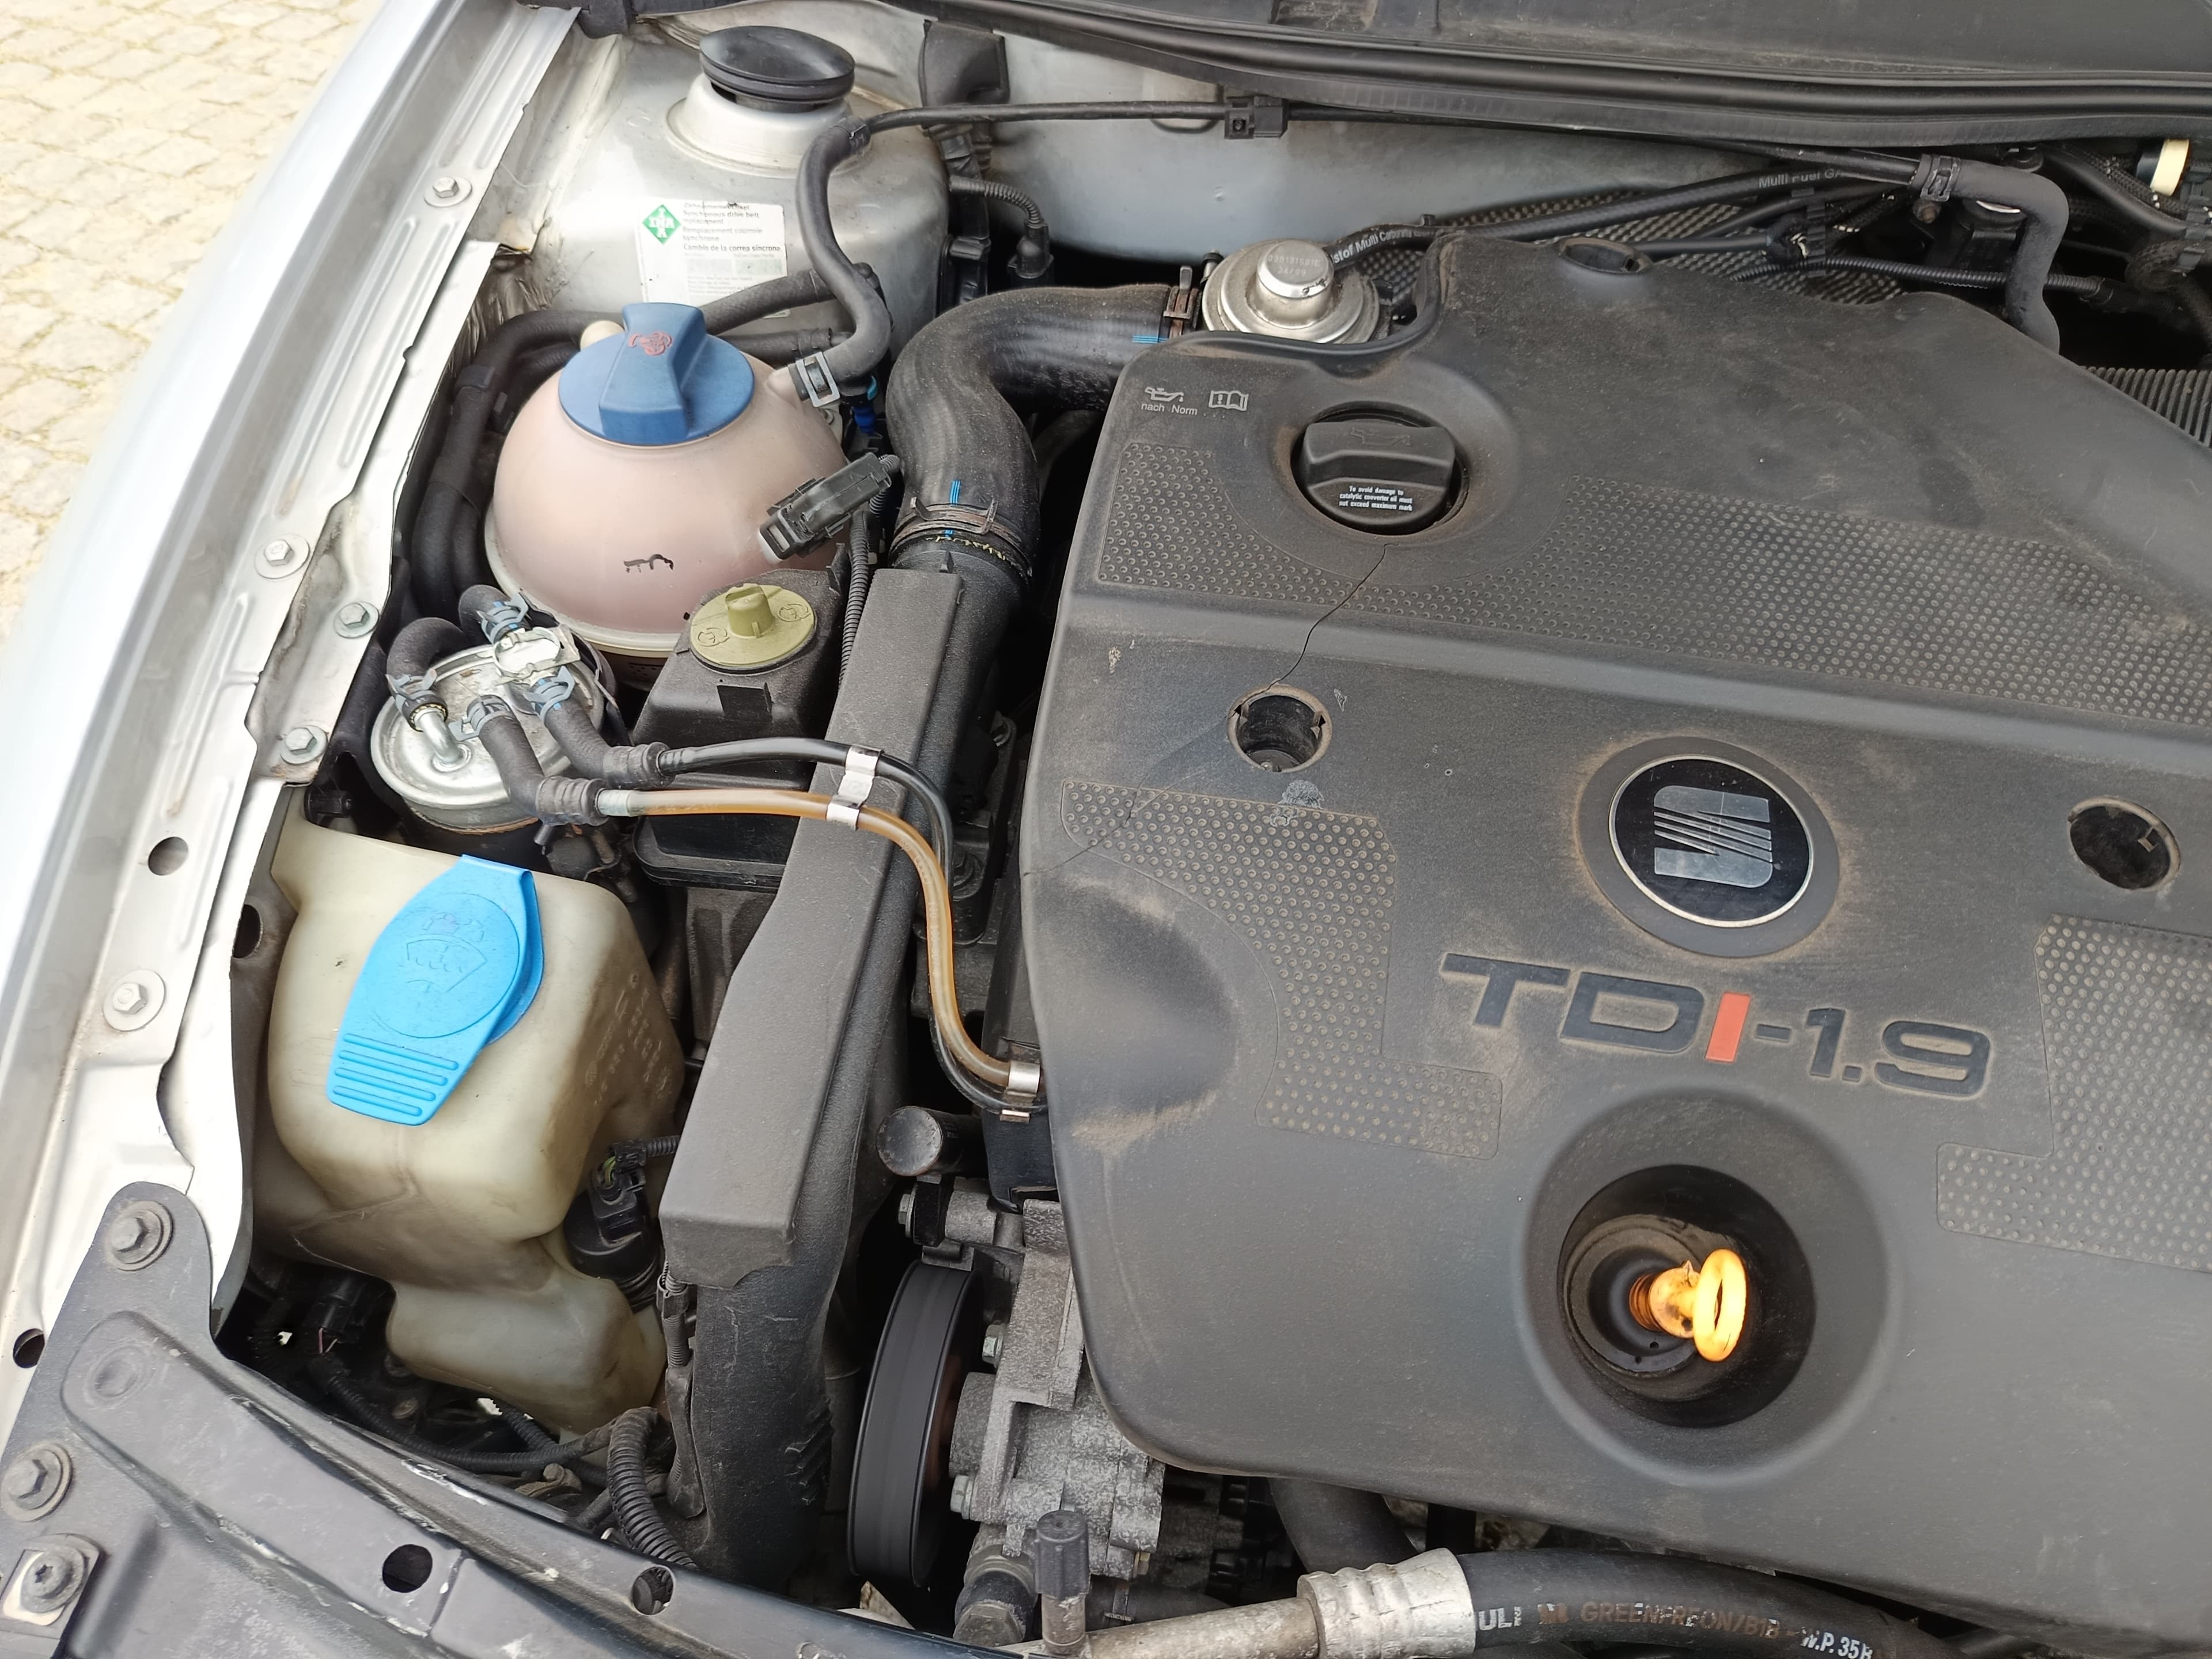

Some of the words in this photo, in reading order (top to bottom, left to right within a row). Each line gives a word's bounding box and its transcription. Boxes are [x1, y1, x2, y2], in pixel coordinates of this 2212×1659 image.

[1331, 244, 1354, 264] stof
[1354, 233, 1379, 253] Multi
[1141, 403, 1165, 412] nach
[1171, 404, 1198, 415] Norm
[1374, 487, 1396, 496] damage
[1474, 1606, 1521, 1631] ULI
